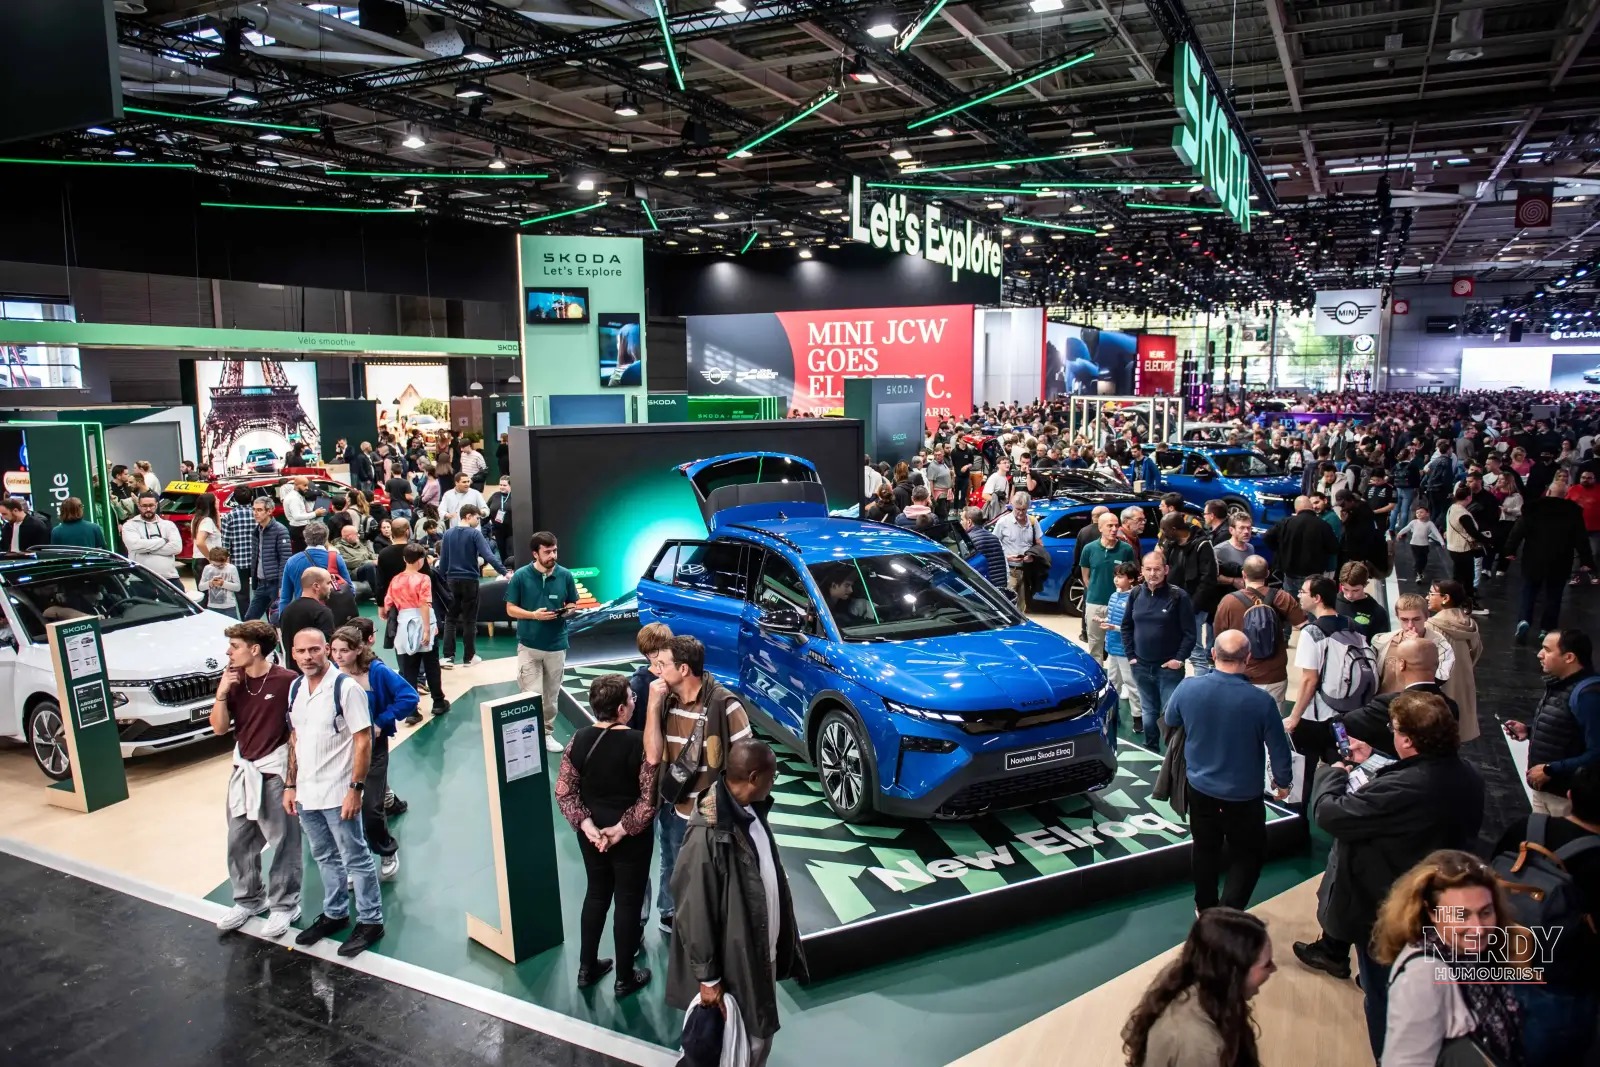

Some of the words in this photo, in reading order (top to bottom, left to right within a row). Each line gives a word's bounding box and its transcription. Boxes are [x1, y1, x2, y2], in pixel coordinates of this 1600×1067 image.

[850, 175, 920, 255] Let's
[923, 205, 1002, 282] Explore
[543, 266, 573, 276] Let's
[577, 266, 622, 278] Explore
[1338, 309, 1358, 317] MINI
[807, 320, 874, 346] MINI
[881, 318, 949, 345] JCW
[318, 337, 356, 346] smoothie
[807, 347, 879, 373] GOES
[924, 407, 952, 417] ARIS.
[1010, 754, 1037, 765] Nouveau
[1037, 751, 1055, 760] Škoda
[1055, 747, 1071, 757] Elroq
[868, 845, 1016, 893] New
[1014, 812, 1188, 857] Elroq
